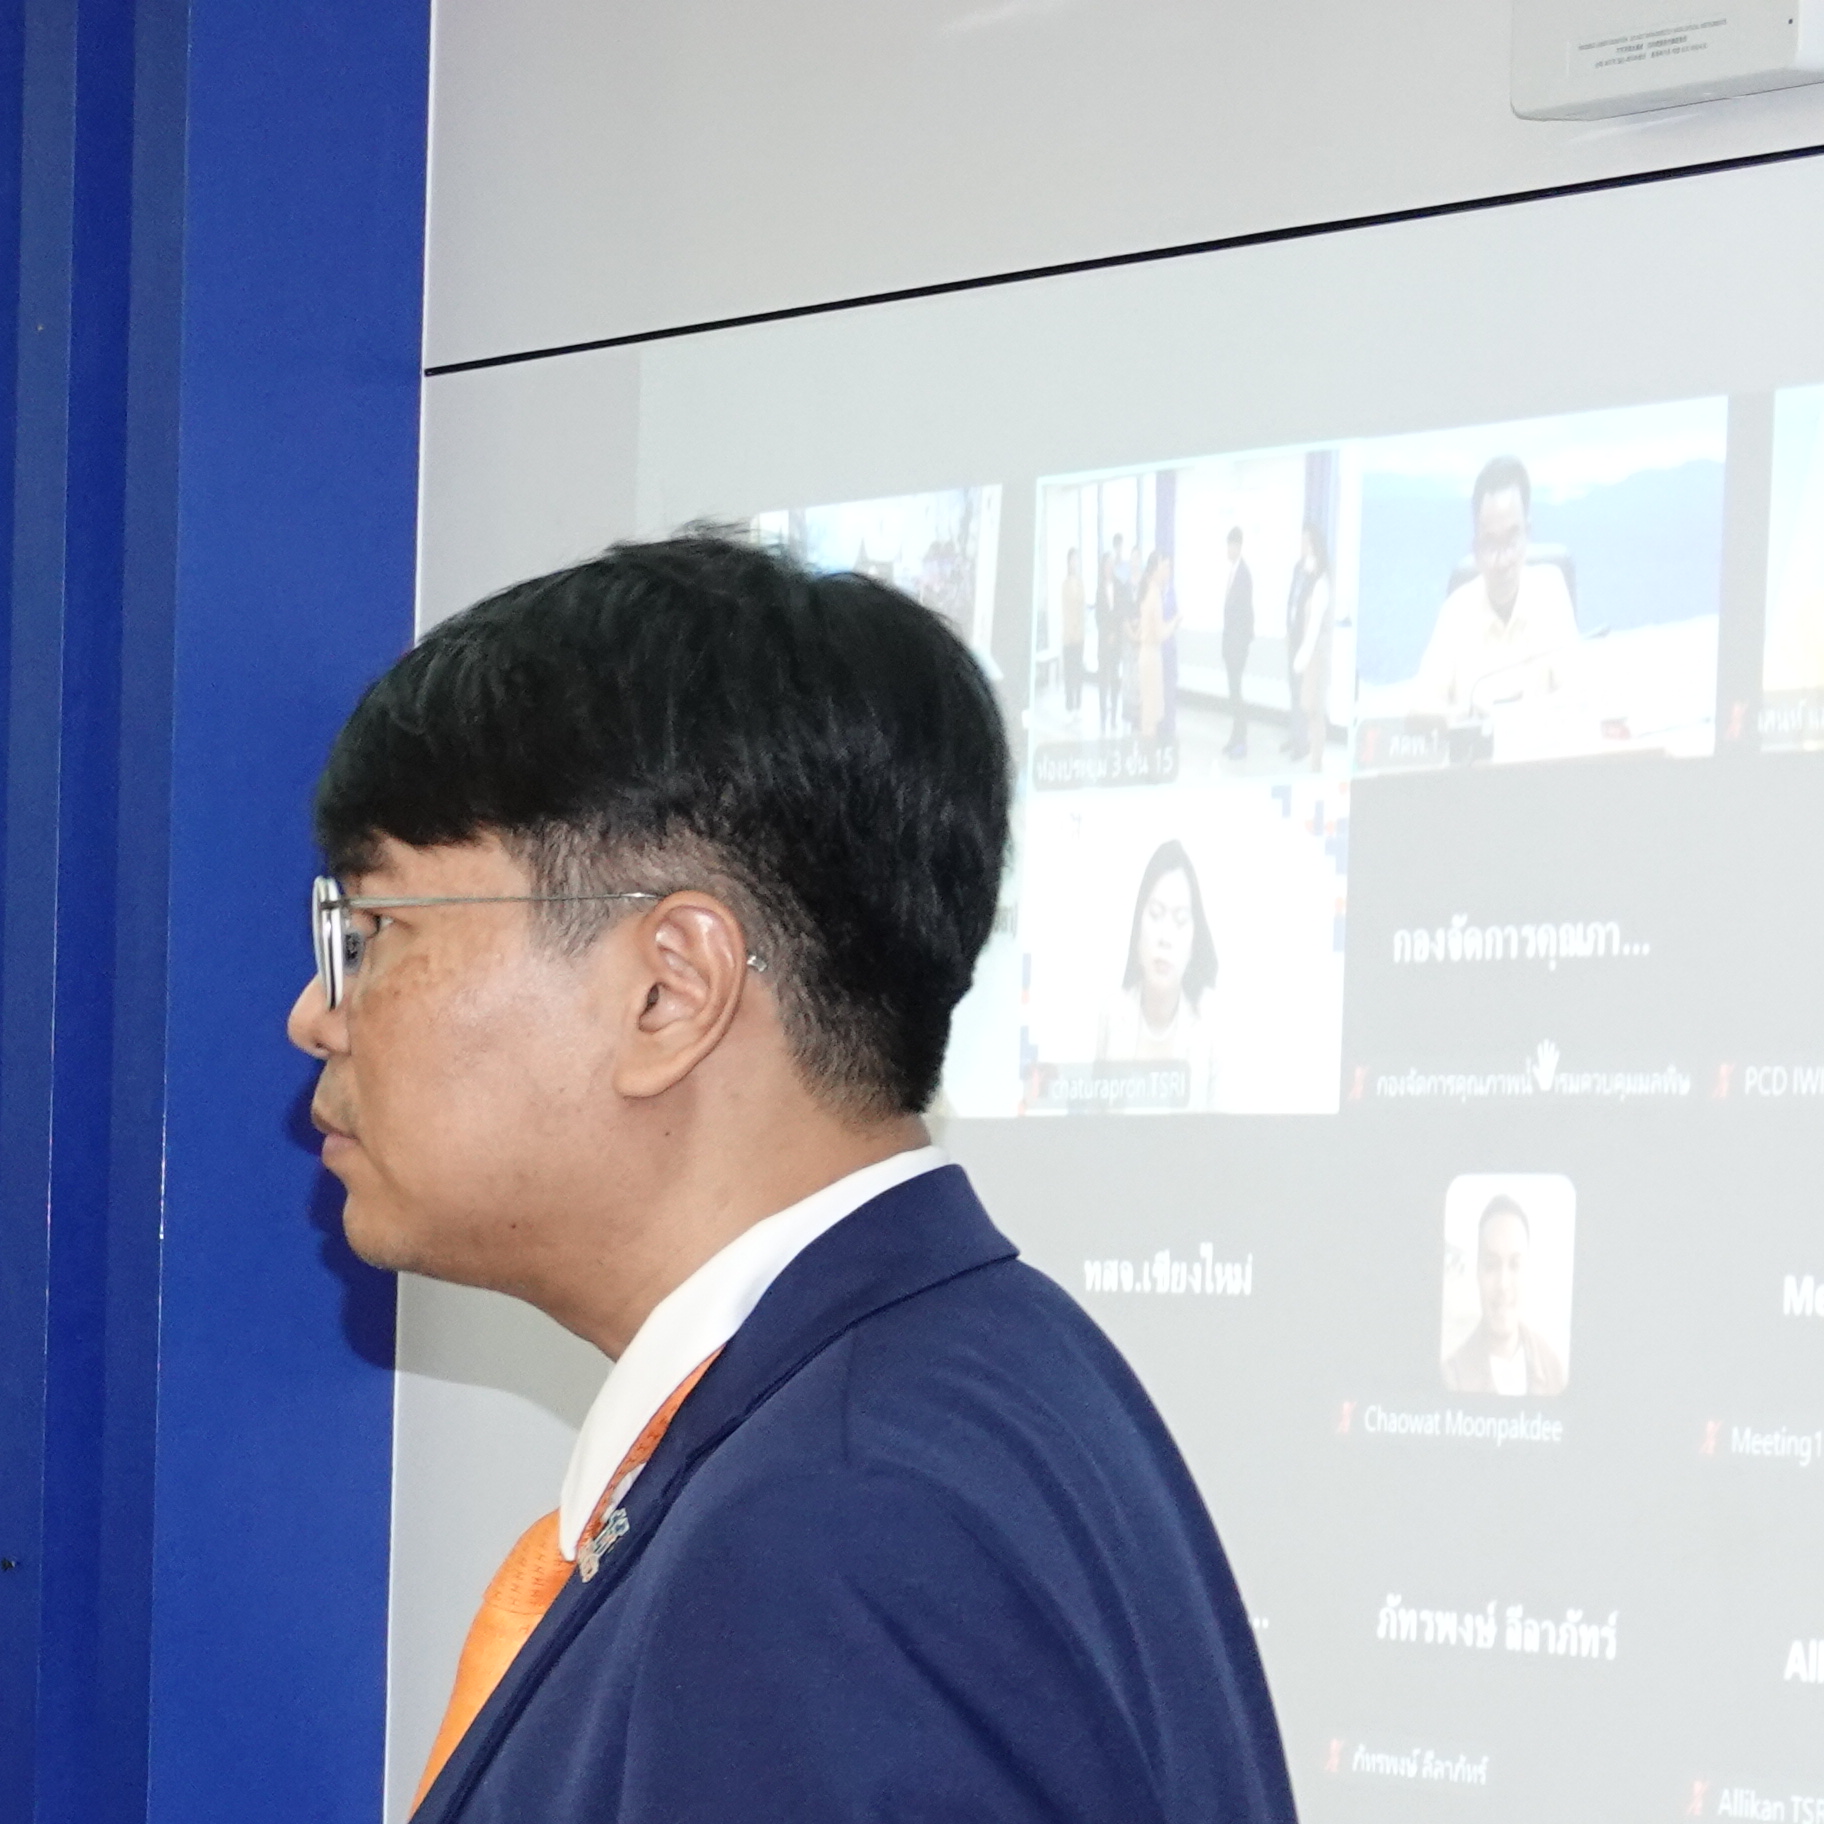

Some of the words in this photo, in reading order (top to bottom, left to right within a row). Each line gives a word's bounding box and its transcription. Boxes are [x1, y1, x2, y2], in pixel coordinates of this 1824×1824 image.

[1155, 747, 1174, 774] 15
[1744, 1066, 1788, 1096] PCD
[1083, 1242, 1253, 1296] ทสจ.เชียงใหม่
[1363, 1404, 1441, 1436] Chaowat
[1445, 1409, 1564, 1447] Moonpakdee
[1717, 1788, 1785, 1821] Allikan
